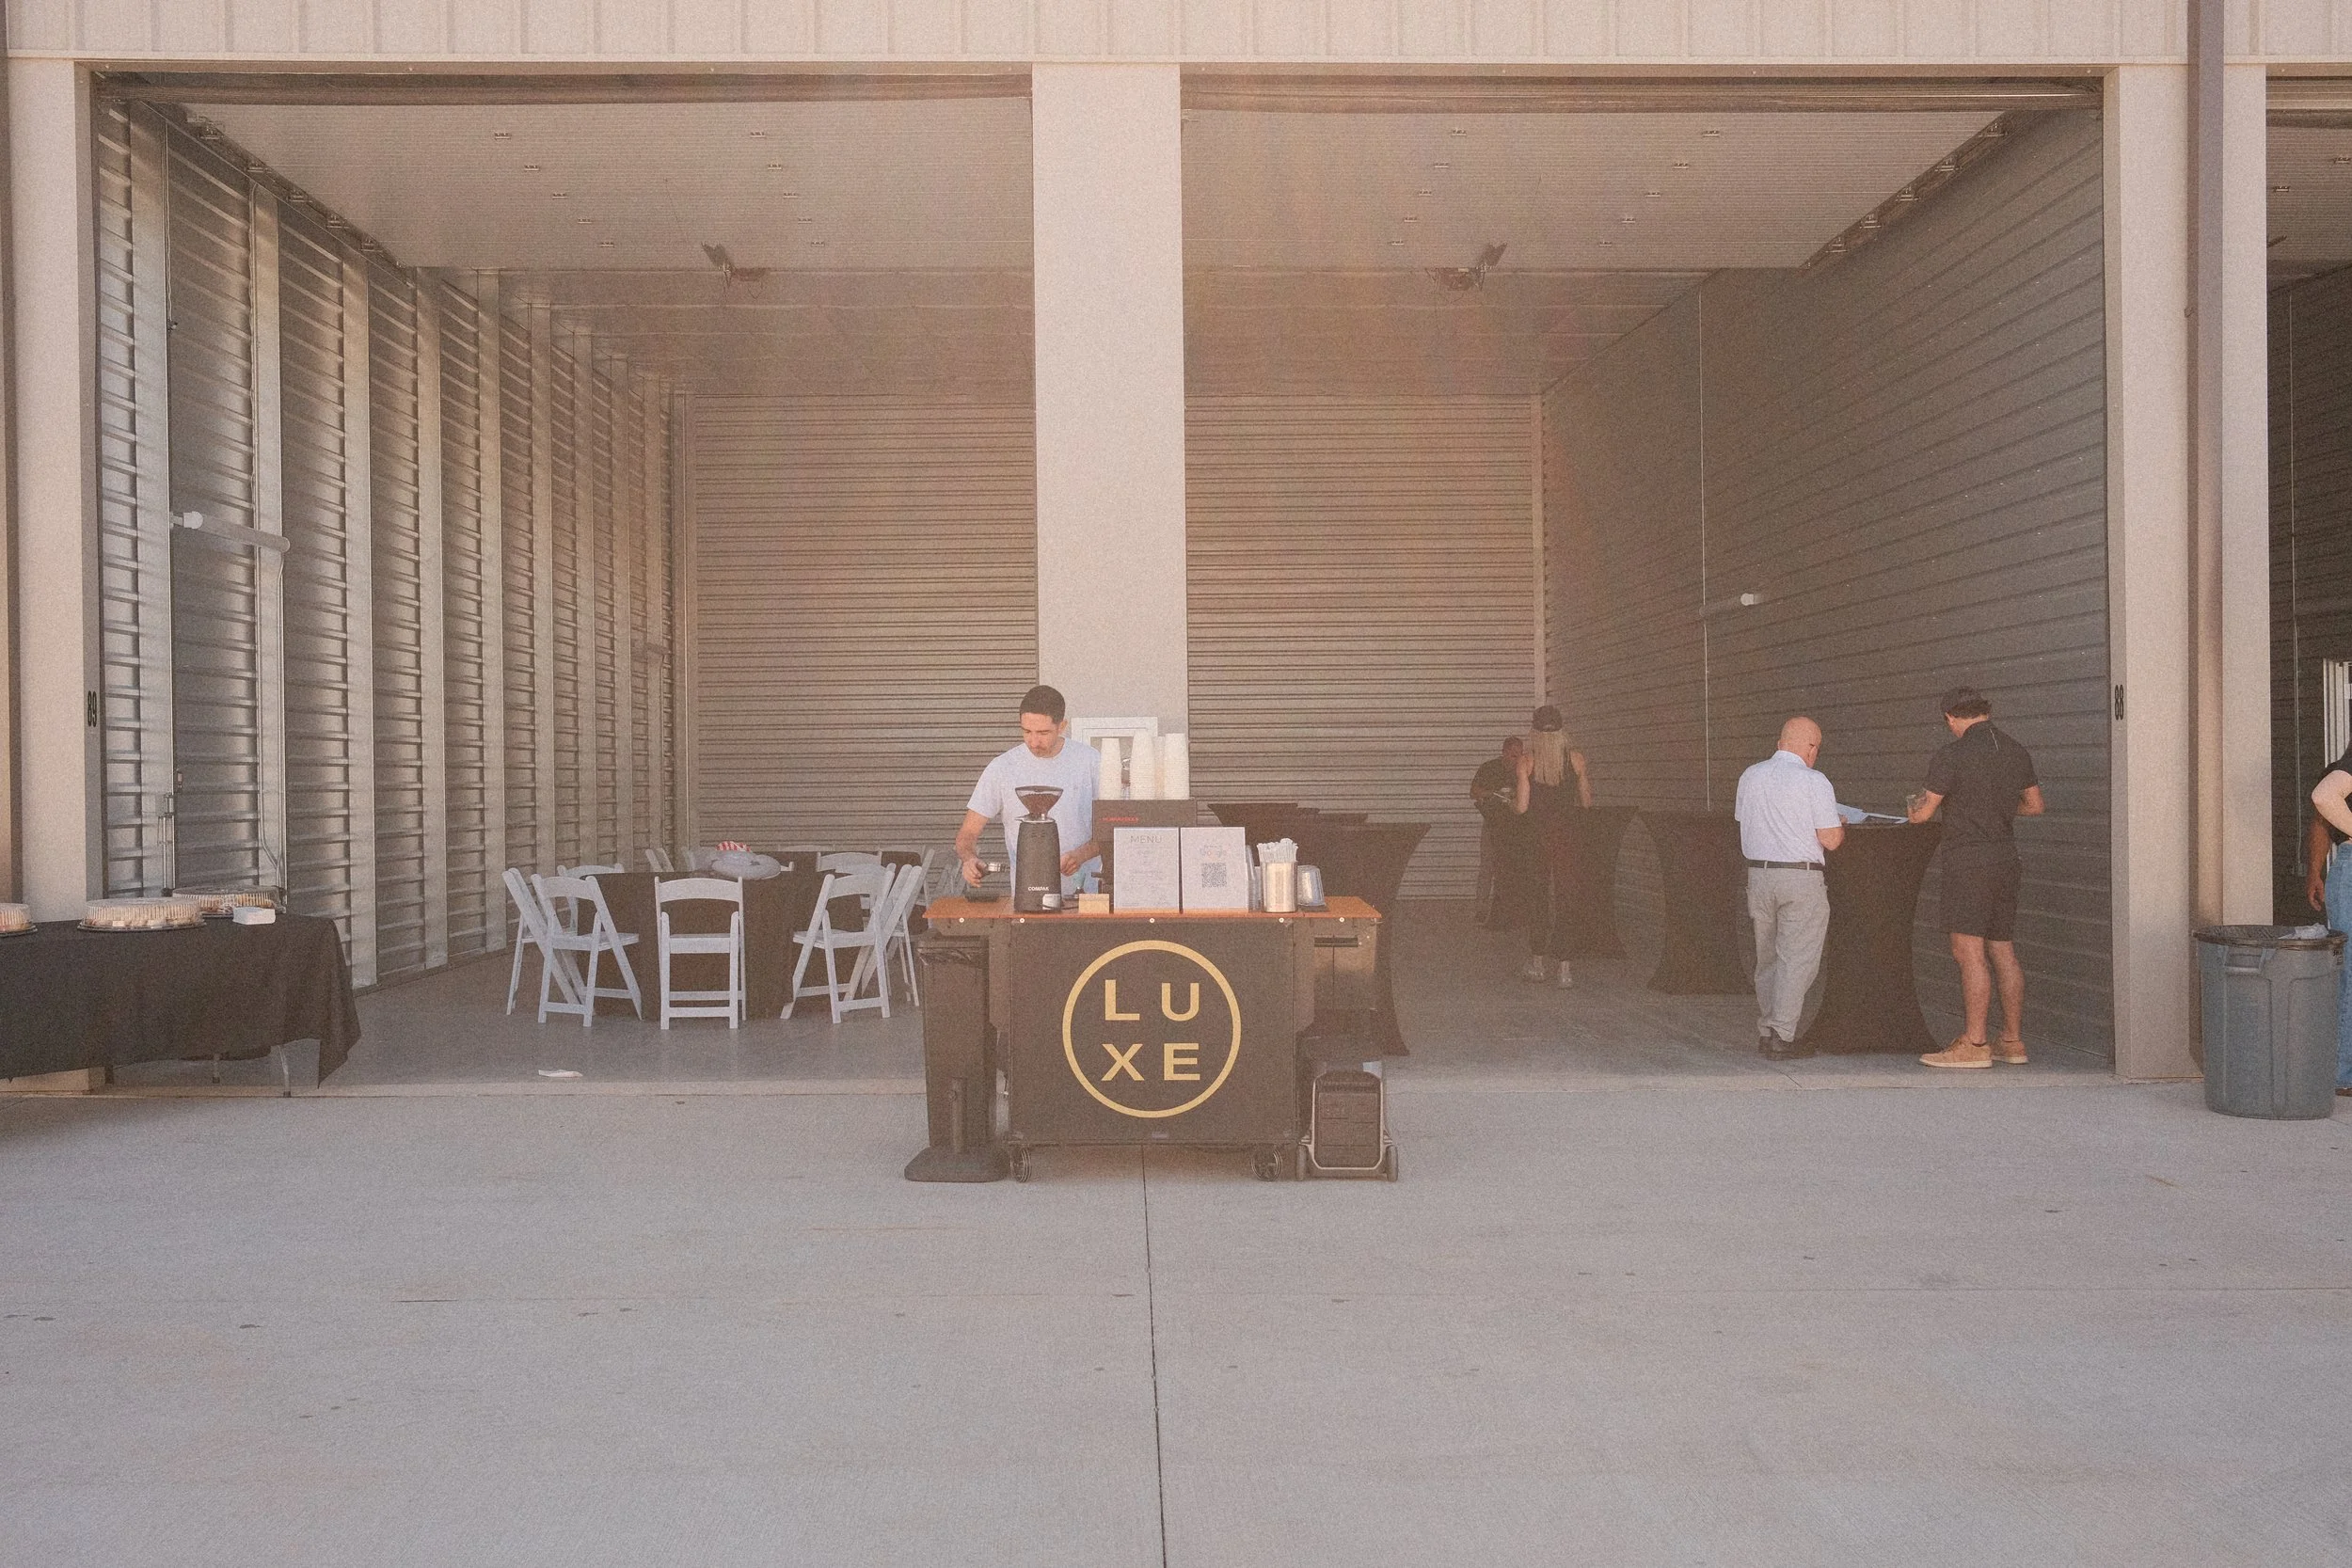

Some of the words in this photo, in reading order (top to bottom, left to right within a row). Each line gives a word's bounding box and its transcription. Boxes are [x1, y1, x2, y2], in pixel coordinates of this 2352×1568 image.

[87, 690, 97, 727] 89
[2114, 684, 2123, 721] 88
[1130, 835, 1163, 844] MENU
